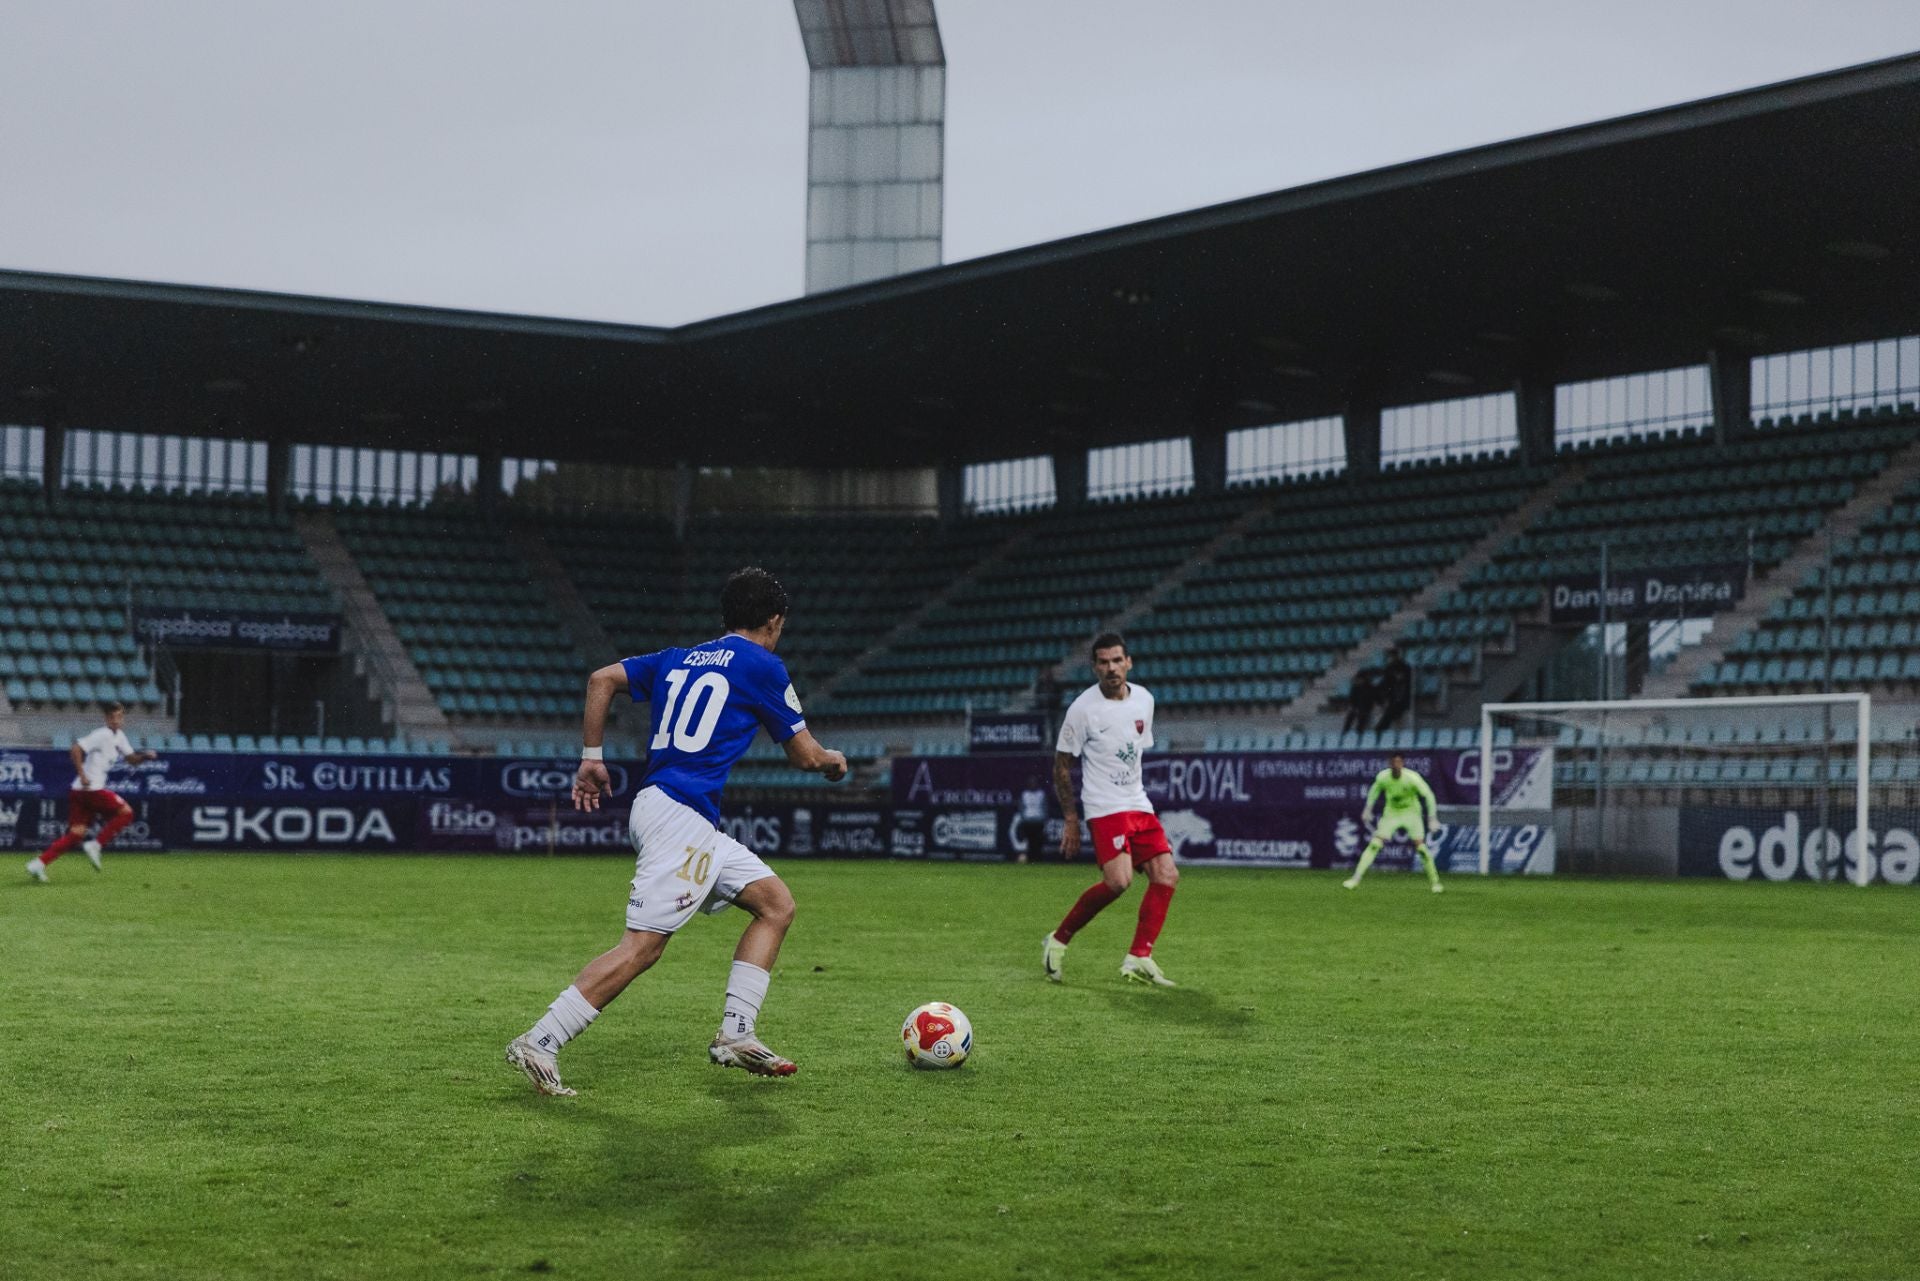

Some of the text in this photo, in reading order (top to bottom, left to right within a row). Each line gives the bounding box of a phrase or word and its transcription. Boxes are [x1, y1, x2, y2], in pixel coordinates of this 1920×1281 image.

[651, 668, 730, 753] 10
[263, 761, 451, 791] SR. CUTILLAS
[1168, 758, 1250, 801] ROYAL
[429, 803, 496, 828] fisio
[676, 845, 711, 886] 10
[1718, 811, 1920, 886] edesa
